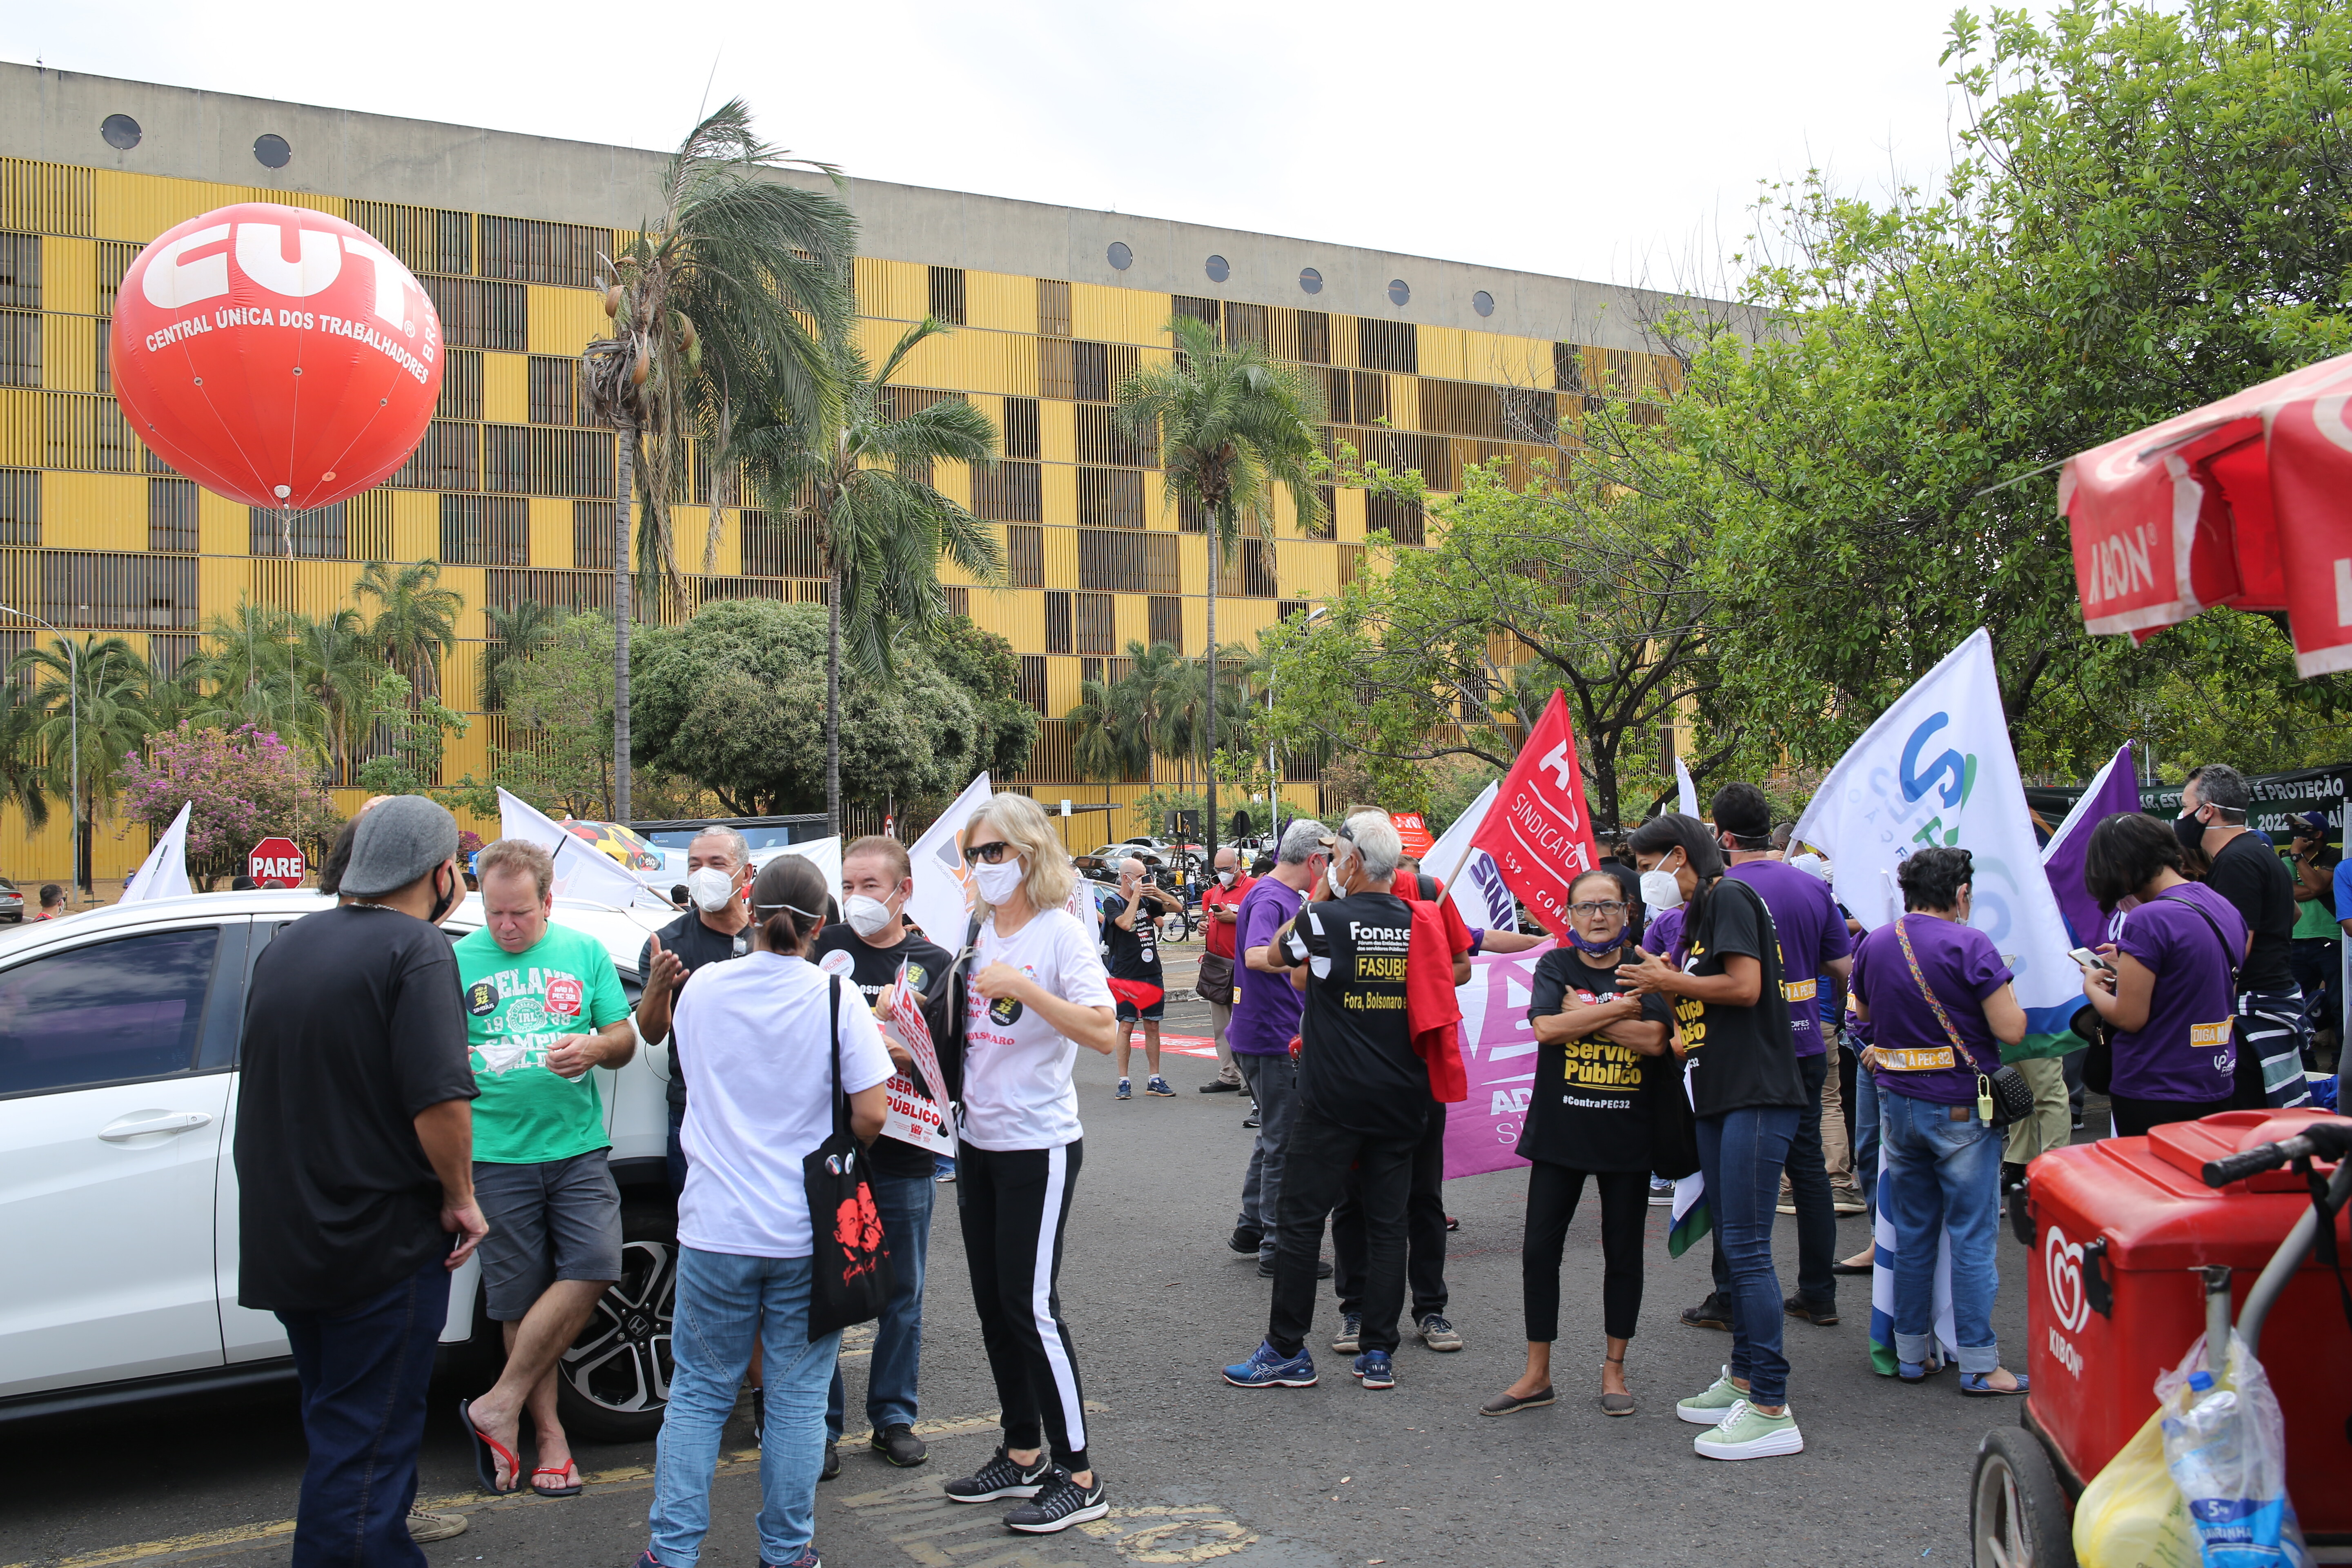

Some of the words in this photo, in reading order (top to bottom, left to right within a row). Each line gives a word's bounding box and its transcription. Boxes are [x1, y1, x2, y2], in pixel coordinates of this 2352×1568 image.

[142, 223, 417, 332] CUT
[146, 314, 213, 353] CENTRAL
[216, 305, 274, 328] ÚNICA
[279, 309, 314, 328] DOS
[319, 314, 429, 385] TRABALHADORES
[2255, 781, 2267, 801] É
[2267, 775, 2344, 801] PROTEÇÃO
[1511, 793, 1578, 869] SINDICATO
[2257, 813, 2289, 831] 2022
[252, 858, 302, 878] PARE
[1505, 851, 1522, 875] CSP
[931, 857, 951, 880] Sindicato
[950, 879, 959, 889] dos
[906, 973, 919, 983] 32
[474, 989, 488, 998] PEC
[1808, 982, 1815, 994] 32
[474, 995, 490, 1007] 32
[995, 1002, 1011, 1015] 32
[1344, 991, 1365, 1012] Fora,
[1366, 991, 1403, 1009] Bolsonaro
[483, 1016, 504, 1033] 19
[518, 1012, 537, 1023] IRL
[2193, 1028, 2216, 1042] DIGA
[1886, 1051, 1907, 1068] NÃO
[1909, 1050, 1915, 1066] À
[1918, 1053, 1936, 1066] PEC
[1938, 1051, 1952, 1065] 32
[1564, 1059, 1642, 1085] Público
[1563, 1095, 1630, 1109] #ContraPEC32
[2049, 1326, 2080, 1382] KIBON
